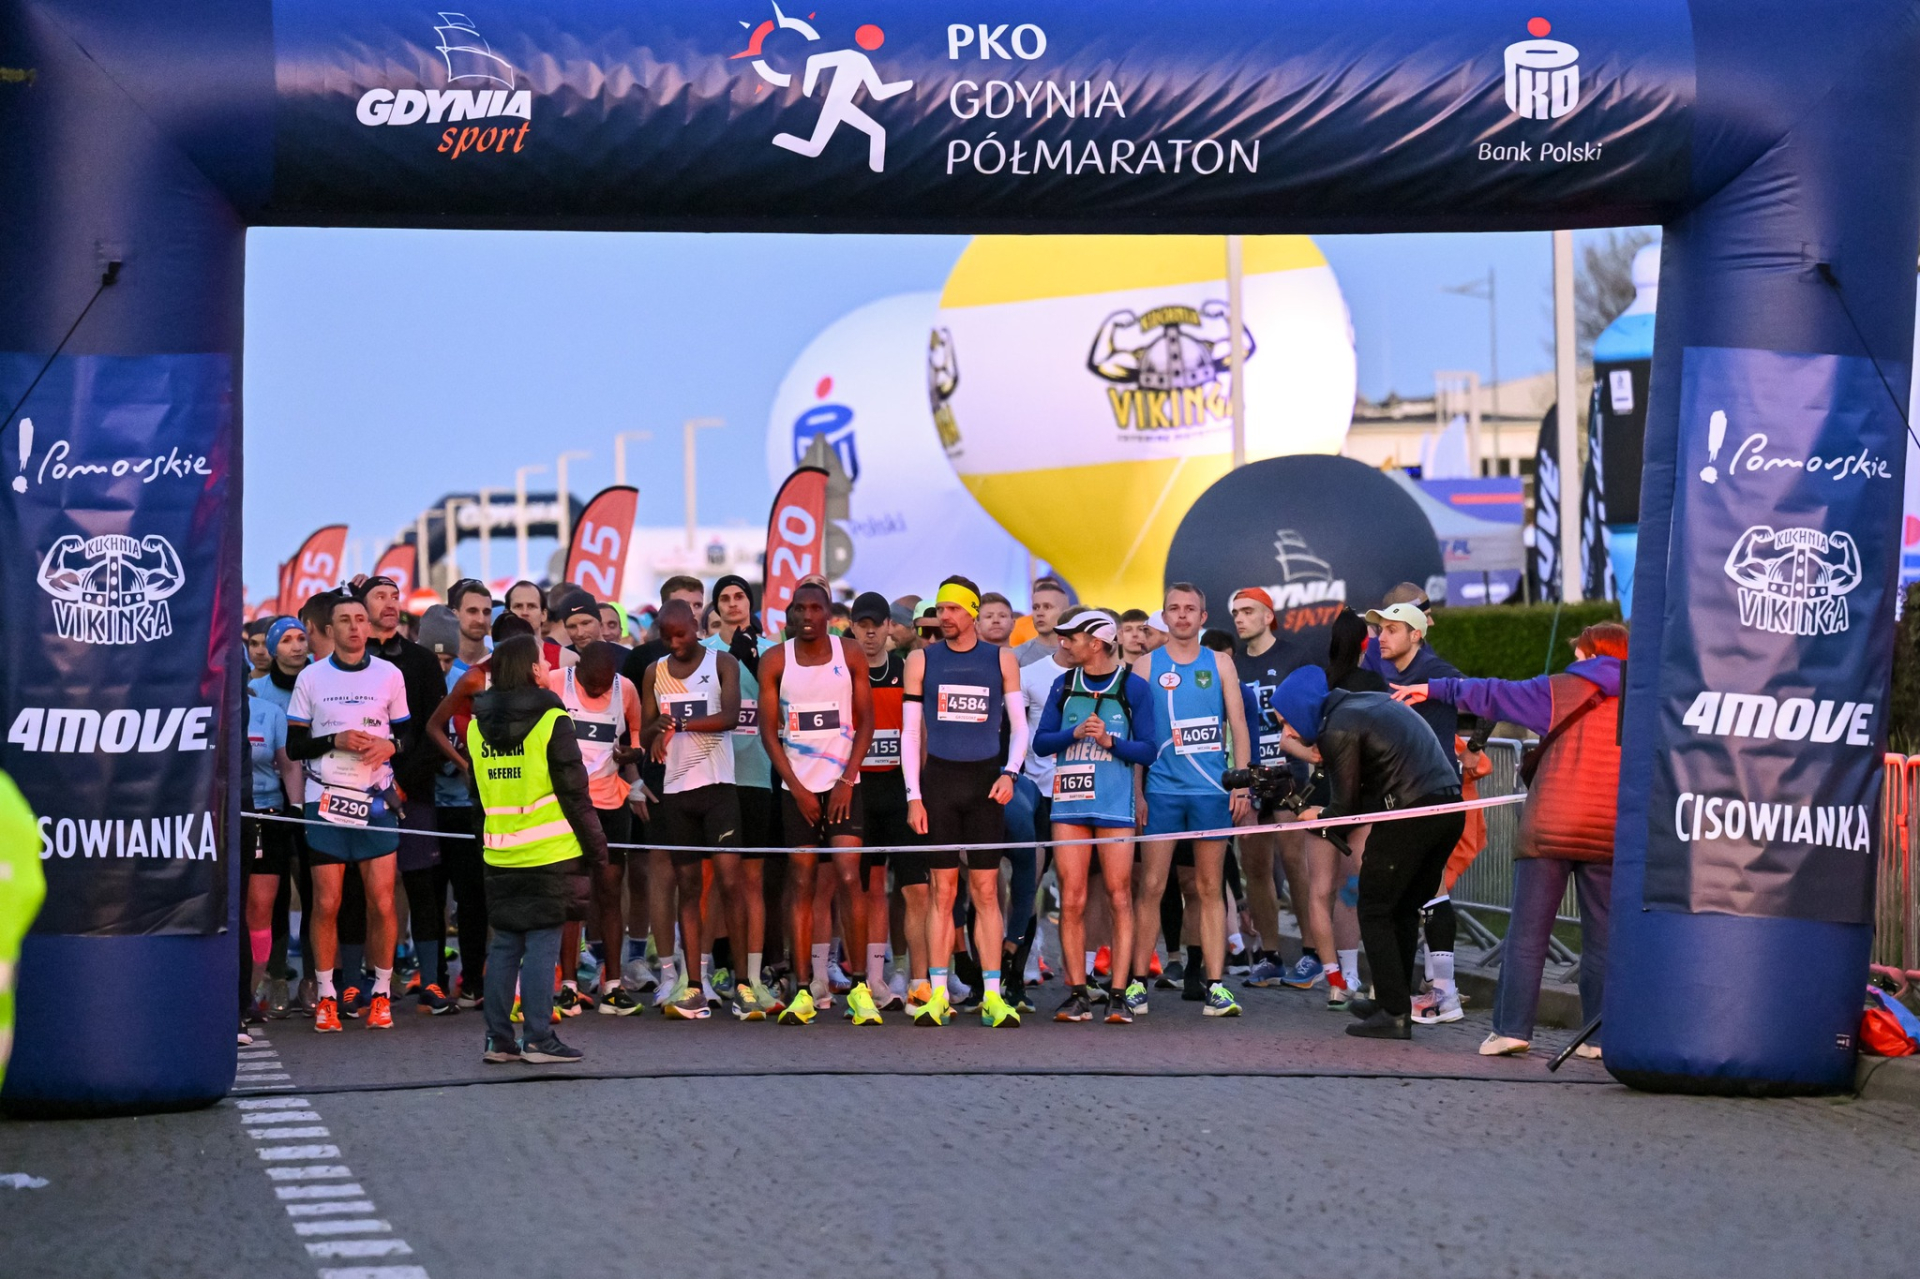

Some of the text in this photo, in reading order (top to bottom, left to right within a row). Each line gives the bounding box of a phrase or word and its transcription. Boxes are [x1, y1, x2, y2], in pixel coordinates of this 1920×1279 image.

[947, 23, 1048, 60] PKO
[356, 88, 532, 126] GDYNIA
[950, 80, 1126, 119] GDYNIA
[437, 120, 531, 160] sport
[946, 131, 1260, 175] PÓŁMARATON
[1478, 141, 1603, 162] Bank Polski
[1107, 382, 1234, 431] VIKING
[38, 440, 212, 483] Pomorskie
[1729, 433, 1892, 481] Pomorskie
[85, 535, 141, 558] KUCHNIA
[1774, 527, 1829, 552] KUCHNIA
[575, 521, 621, 597] 25
[52, 600, 172, 645] VIKINGA
[1737, 588, 1850, 636] VIKINGA
[684, 704, 693, 717] 5
[813, 714, 824, 727] 6
[948, 697, 987, 711] 4584
[1683, 692, 1874, 745] 4MOVE
[8, 707, 213, 753] 4MOVE
[588, 725, 598, 738] 2
[867, 741, 898, 755] 155
[1183, 727, 1218, 742] 4067
[487, 767, 522, 780] REFEREE
[1062, 776, 1093, 789] 1676
[330, 798, 369, 818] 2290
[1674, 792, 1871, 853] CISOWIANKA
[37, 812, 217, 862] SOWIANKA
